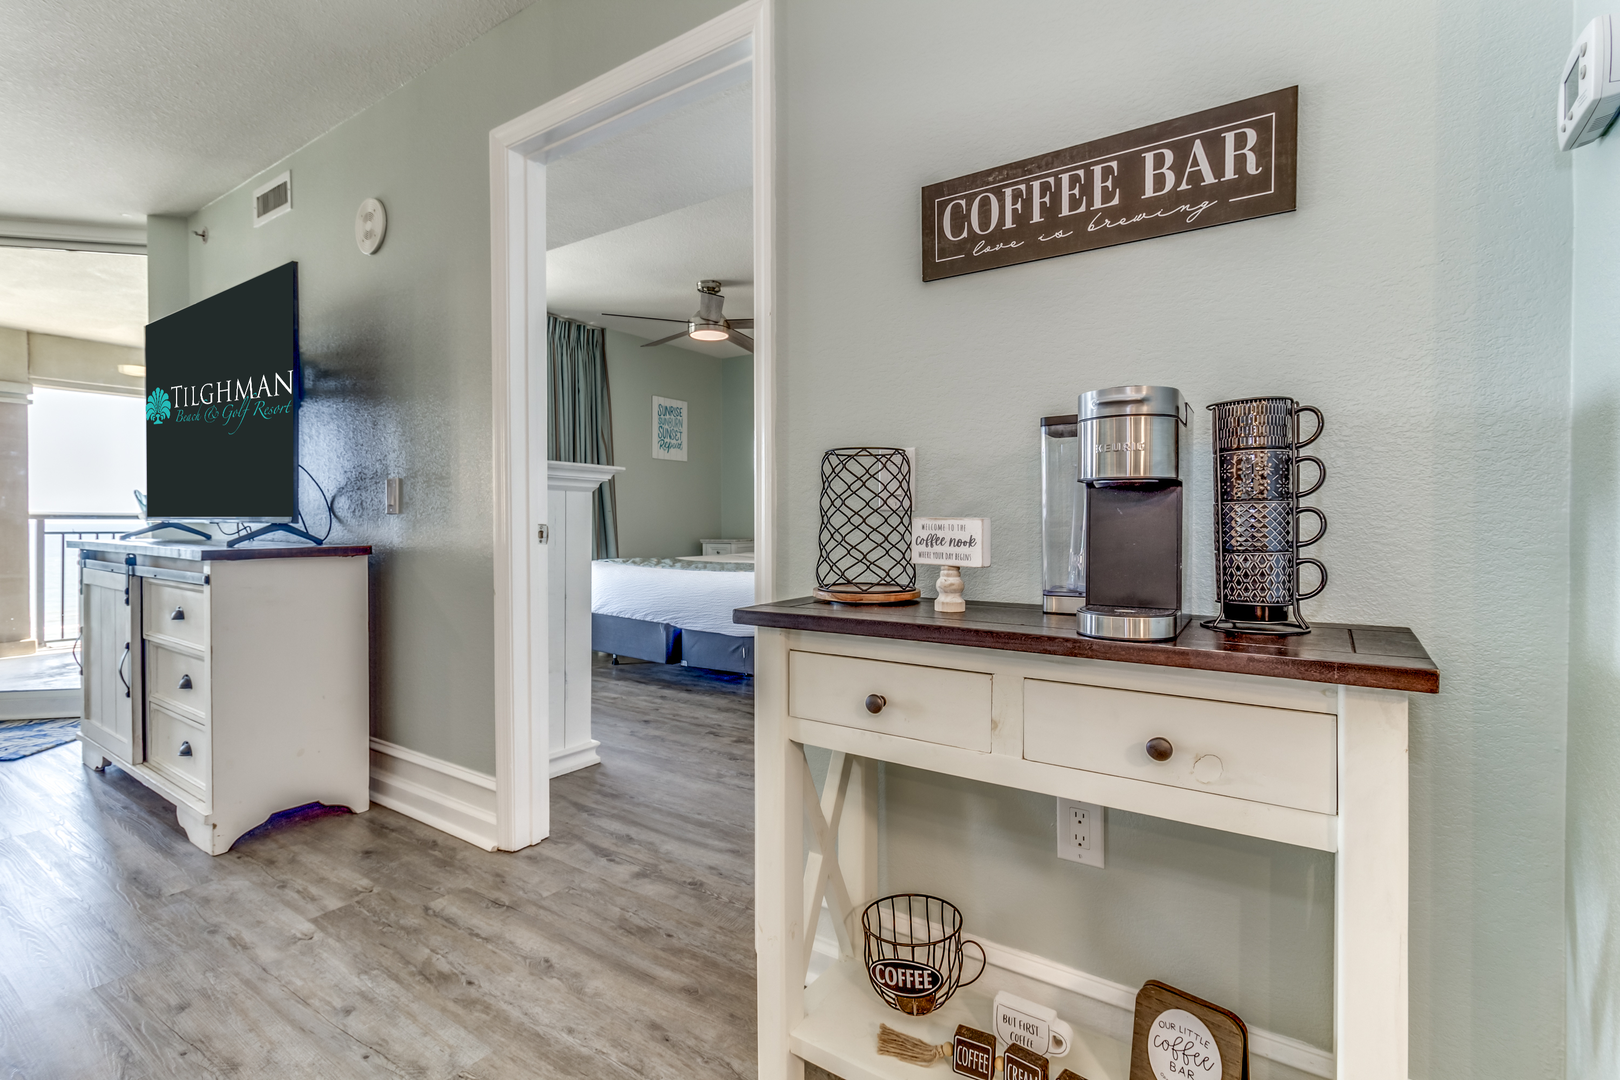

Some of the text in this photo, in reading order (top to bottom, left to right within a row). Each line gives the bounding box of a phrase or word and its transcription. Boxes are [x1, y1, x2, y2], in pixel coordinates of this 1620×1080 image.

[942, 127, 1263, 242] COFFEE BAR
[972, 200, 1219, 257] love is brewing
[170, 369, 294, 409] TILGHMAN
[175, 393, 293, 435] Beach & Golf Resort
[657, 403, 683, 418] SUNRISE
[657, 425, 683, 441] SUNSET
[1095, 441, 1146, 454] KEURIG
[921, 523, 966, 532] WELCOME TO THE
[915, 533, 978, 549] coffee nook
[918, 551, 972, 562] WHERE YOUR DAY BEGINS
[875, 964, 933, 989] COFFEE
[1002, 1013, 1039, 1037] BUT FIRST
[1158, 1020, 1211, 1050] OUR LITTLE
[1009, 1031, 1034, 1049] COFFEE
[956, 1045, 989, 1074] COFFEE
[1153, 1034, 1215, 1072] coffee
[1169, 1060, 1195, 1080] BAR
